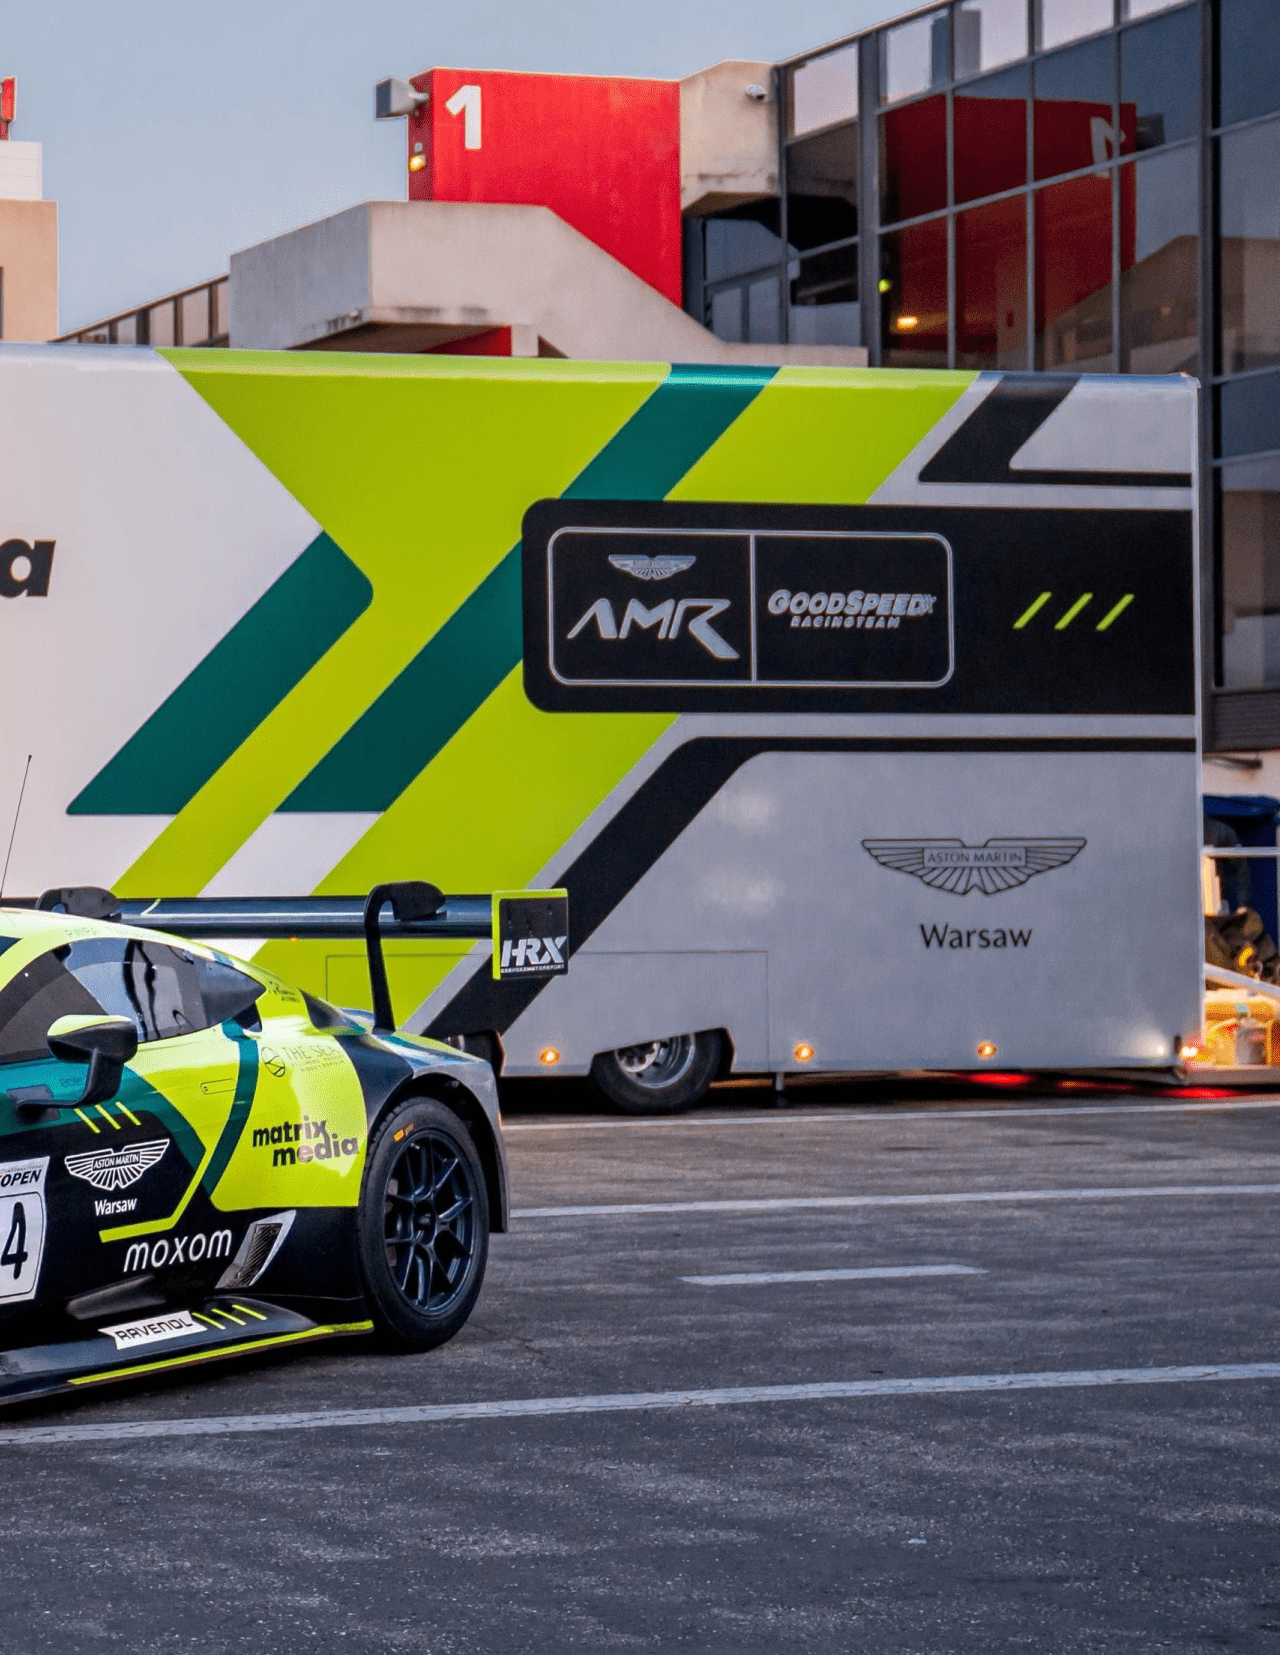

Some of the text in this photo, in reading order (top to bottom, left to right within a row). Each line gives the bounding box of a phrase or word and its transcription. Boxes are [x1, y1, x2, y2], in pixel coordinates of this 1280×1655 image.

[446, 85, 482, 149] 1
[567, 598, 740, 659] AMR
[927, 851, 1023, 864] ASTON MARTIN
[920, 922, 1033, 949] Warsaw
[501, 936, 567, 967] HRX
[252, 1115, 327, 1147] matrix
[93, 1153, 140, 1169] ASTON MARTIN
[272, 1133, 359, 1167] media
[94, 1198, 138, 1216] Warsaw
[123, 1229, 232, 1272] moxom
[114, 1317, 194, 1341] RAVENOL
